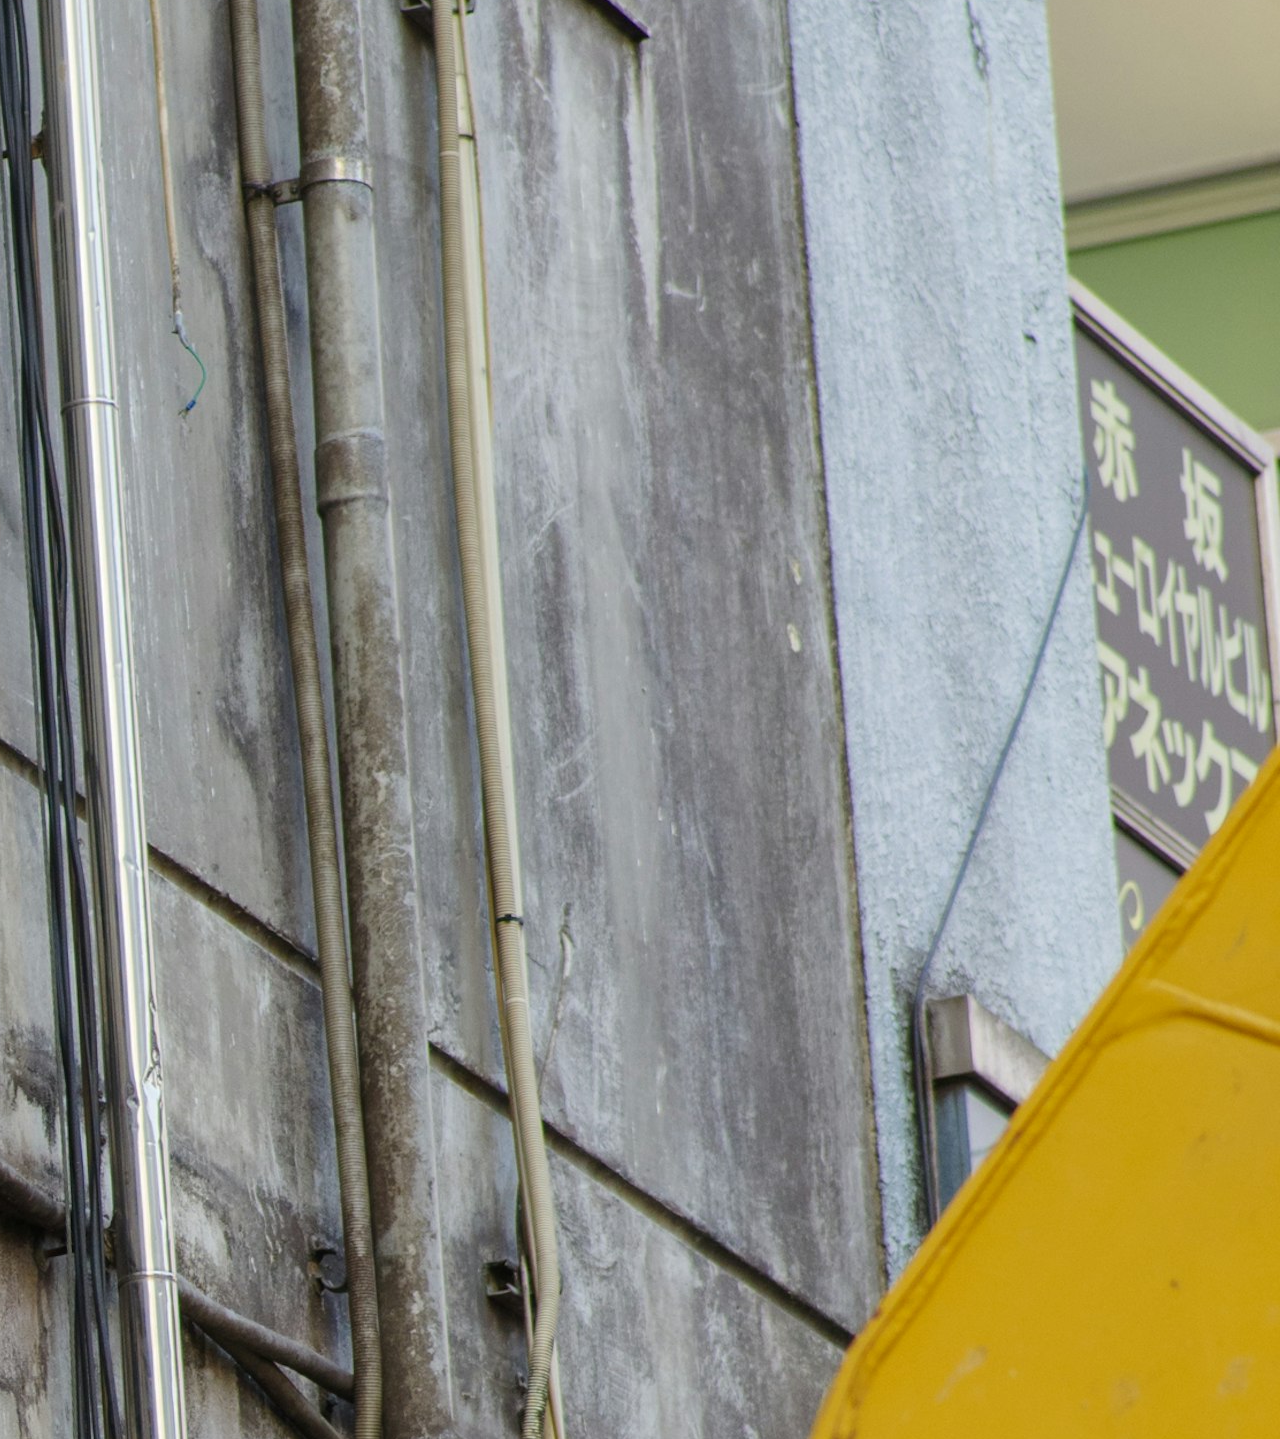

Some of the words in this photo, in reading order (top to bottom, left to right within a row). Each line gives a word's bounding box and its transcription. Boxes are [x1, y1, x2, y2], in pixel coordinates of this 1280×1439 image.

[1086, 520, 1270, 733] ューロイヤルビル
